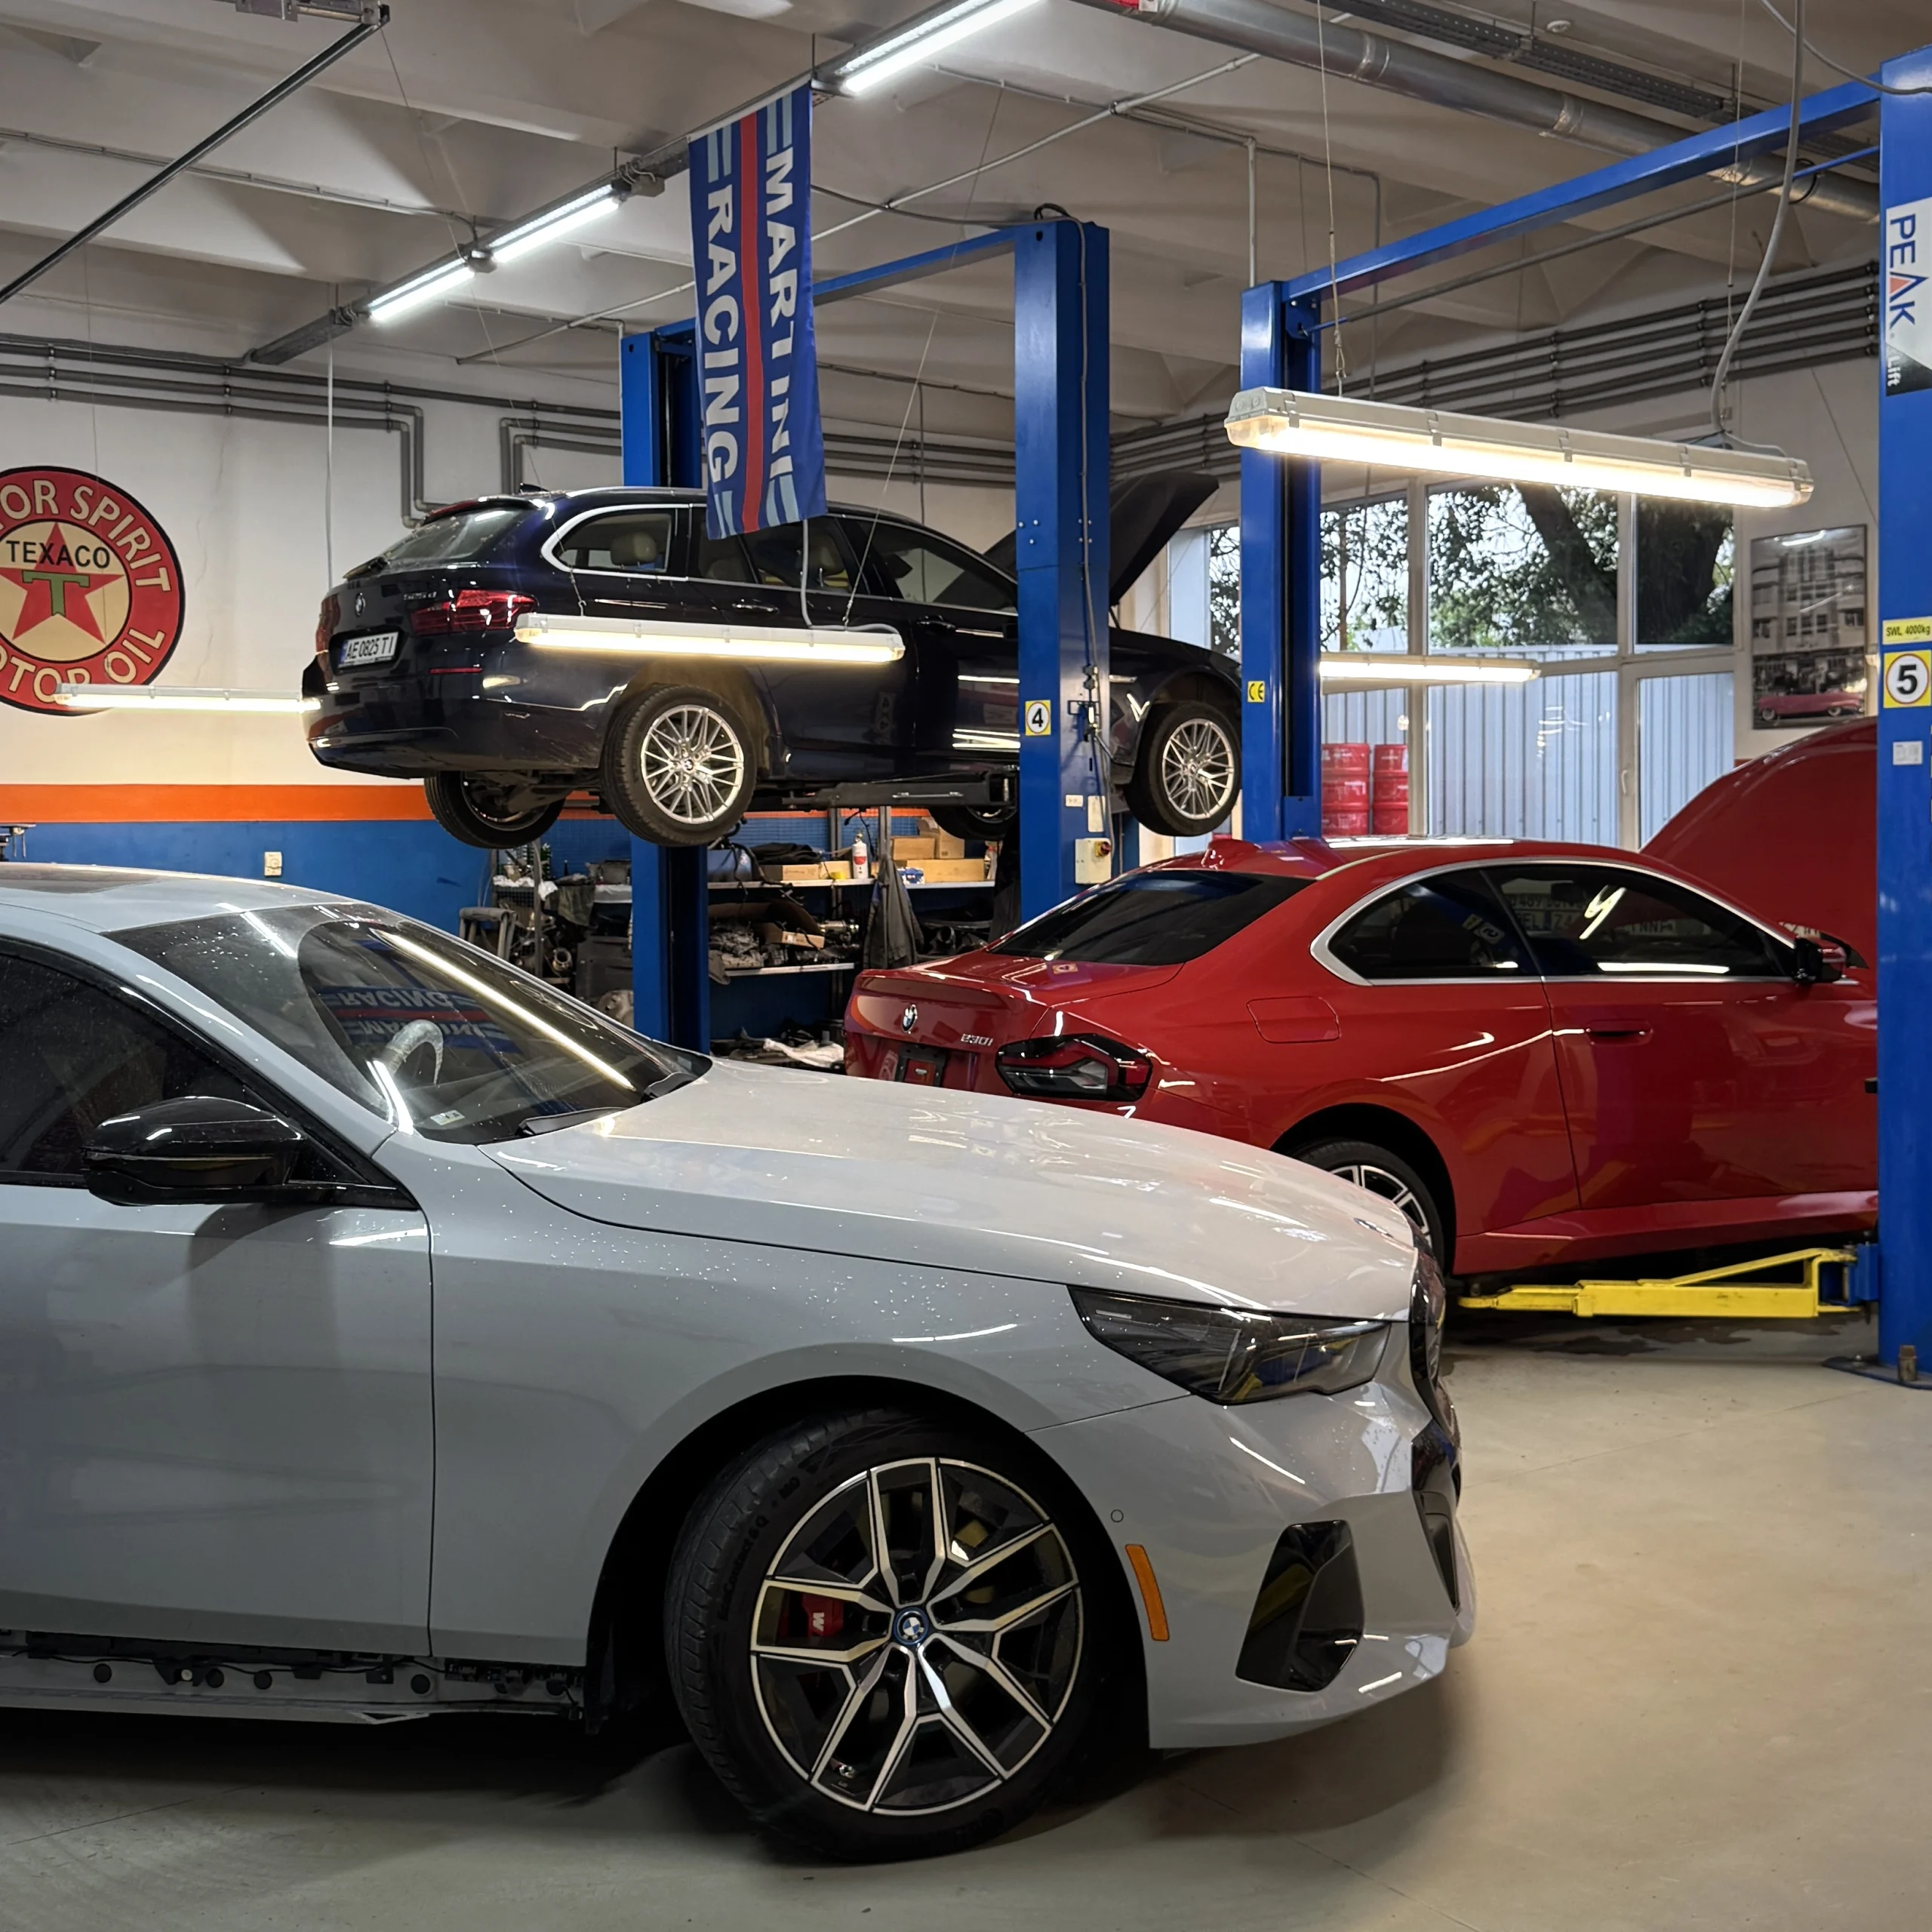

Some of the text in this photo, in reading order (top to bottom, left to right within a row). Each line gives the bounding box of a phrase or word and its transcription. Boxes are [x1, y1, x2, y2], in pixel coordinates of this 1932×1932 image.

[1889, 214, 1930, 330] PEAK
[704, 184, 739, 483] RACING
[766, 146, 798, 479] MARTINI
[1887, 356, 1901, 386] Lift
[0, 479, 171, 592] OR SPIRIT
[6, 540, 111, 569] TEXACO
[22, 569, 91, 617] T
[104, 628, 166, 684] OIL
[1896, 664, 1918, 695] 5
[1249, 682, 1264, 700] CE
[1032, 708, 1044, 728] 4
